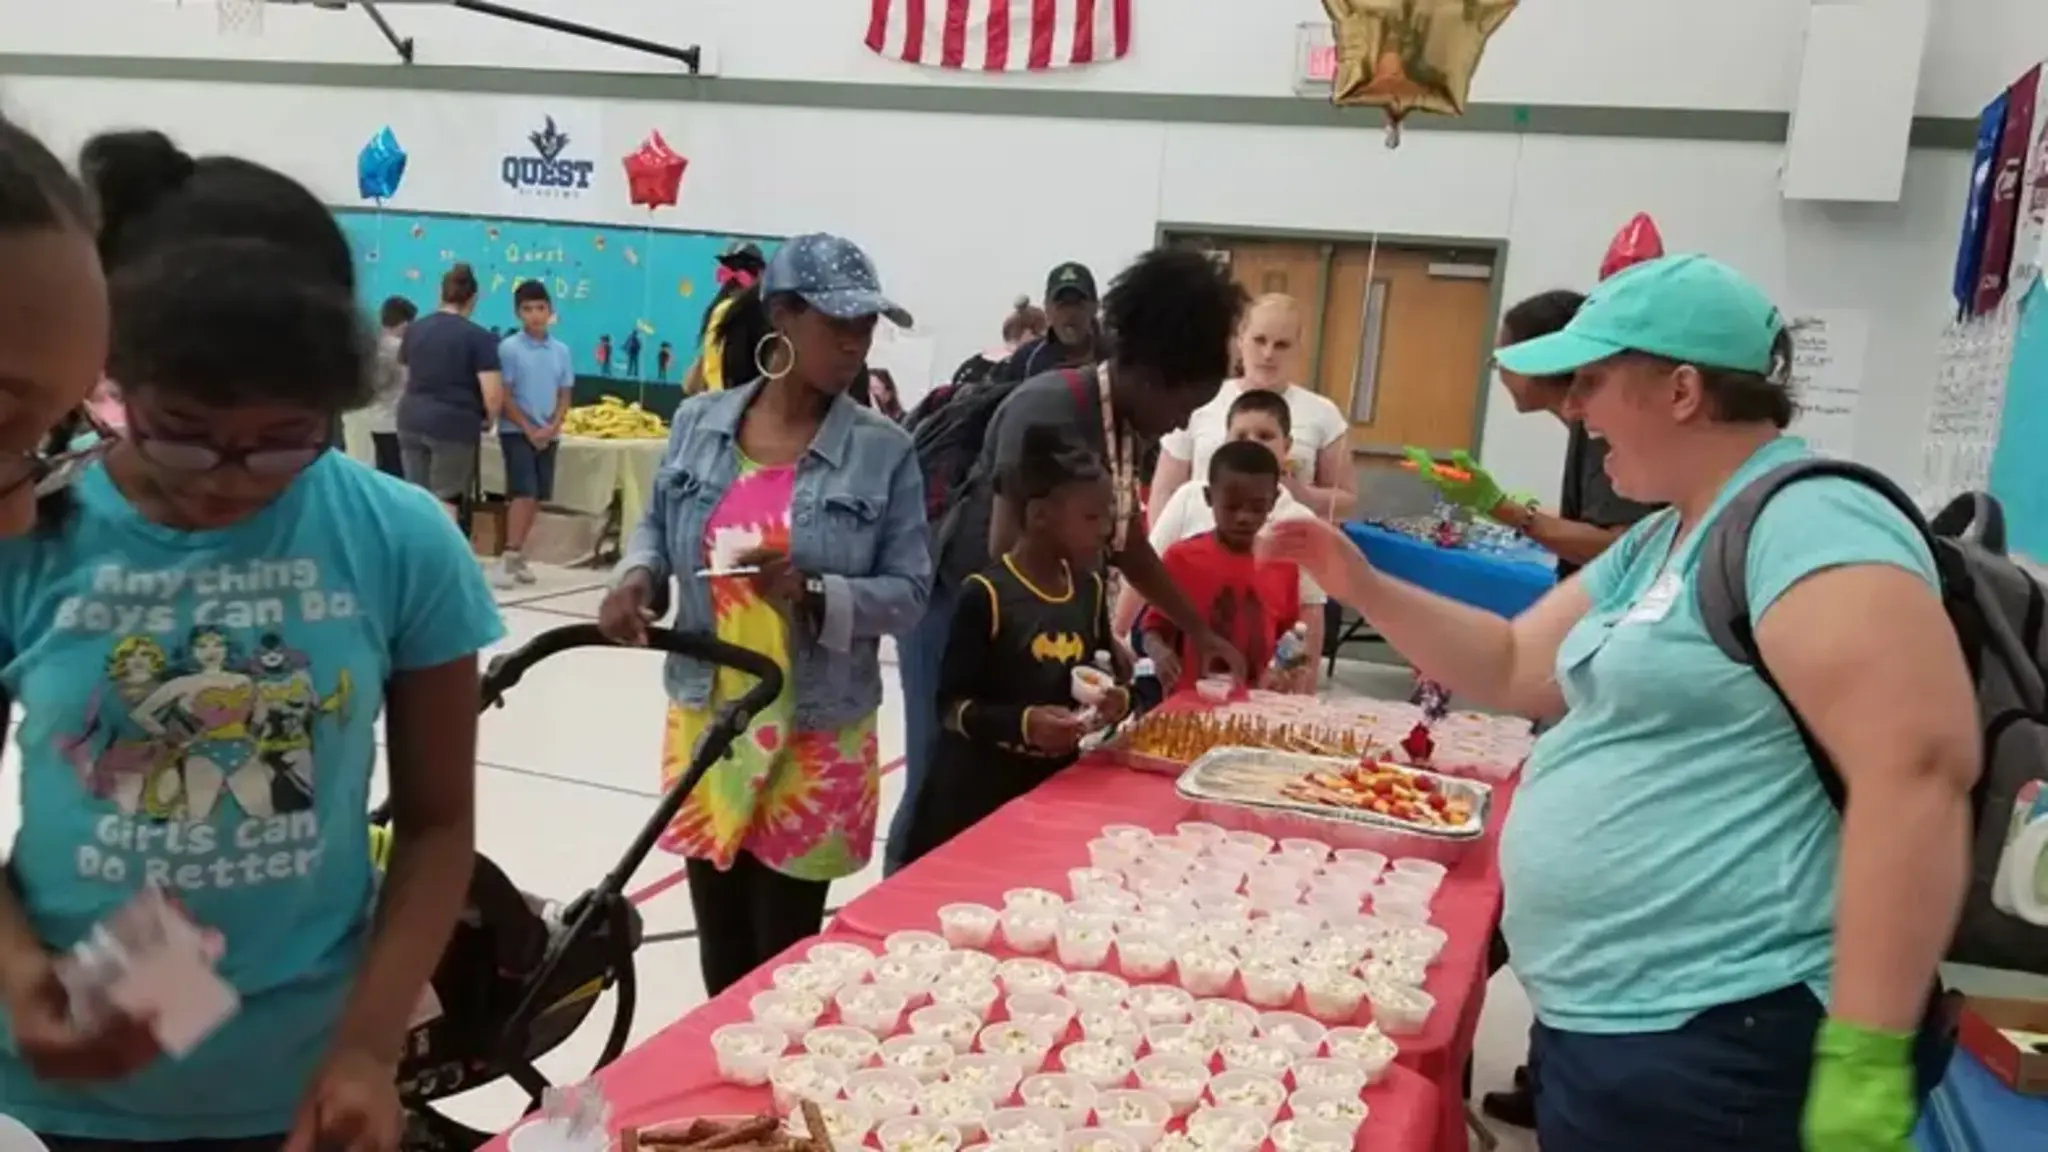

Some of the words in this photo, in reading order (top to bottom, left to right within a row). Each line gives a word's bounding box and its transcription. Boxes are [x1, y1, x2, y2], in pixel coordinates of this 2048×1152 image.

[502, 156, 594, 189] QUEST
[54, 597, 175, 633] Boys
[96, 813, 218, 854] Girls
[78, 845, 126, 882] Do
